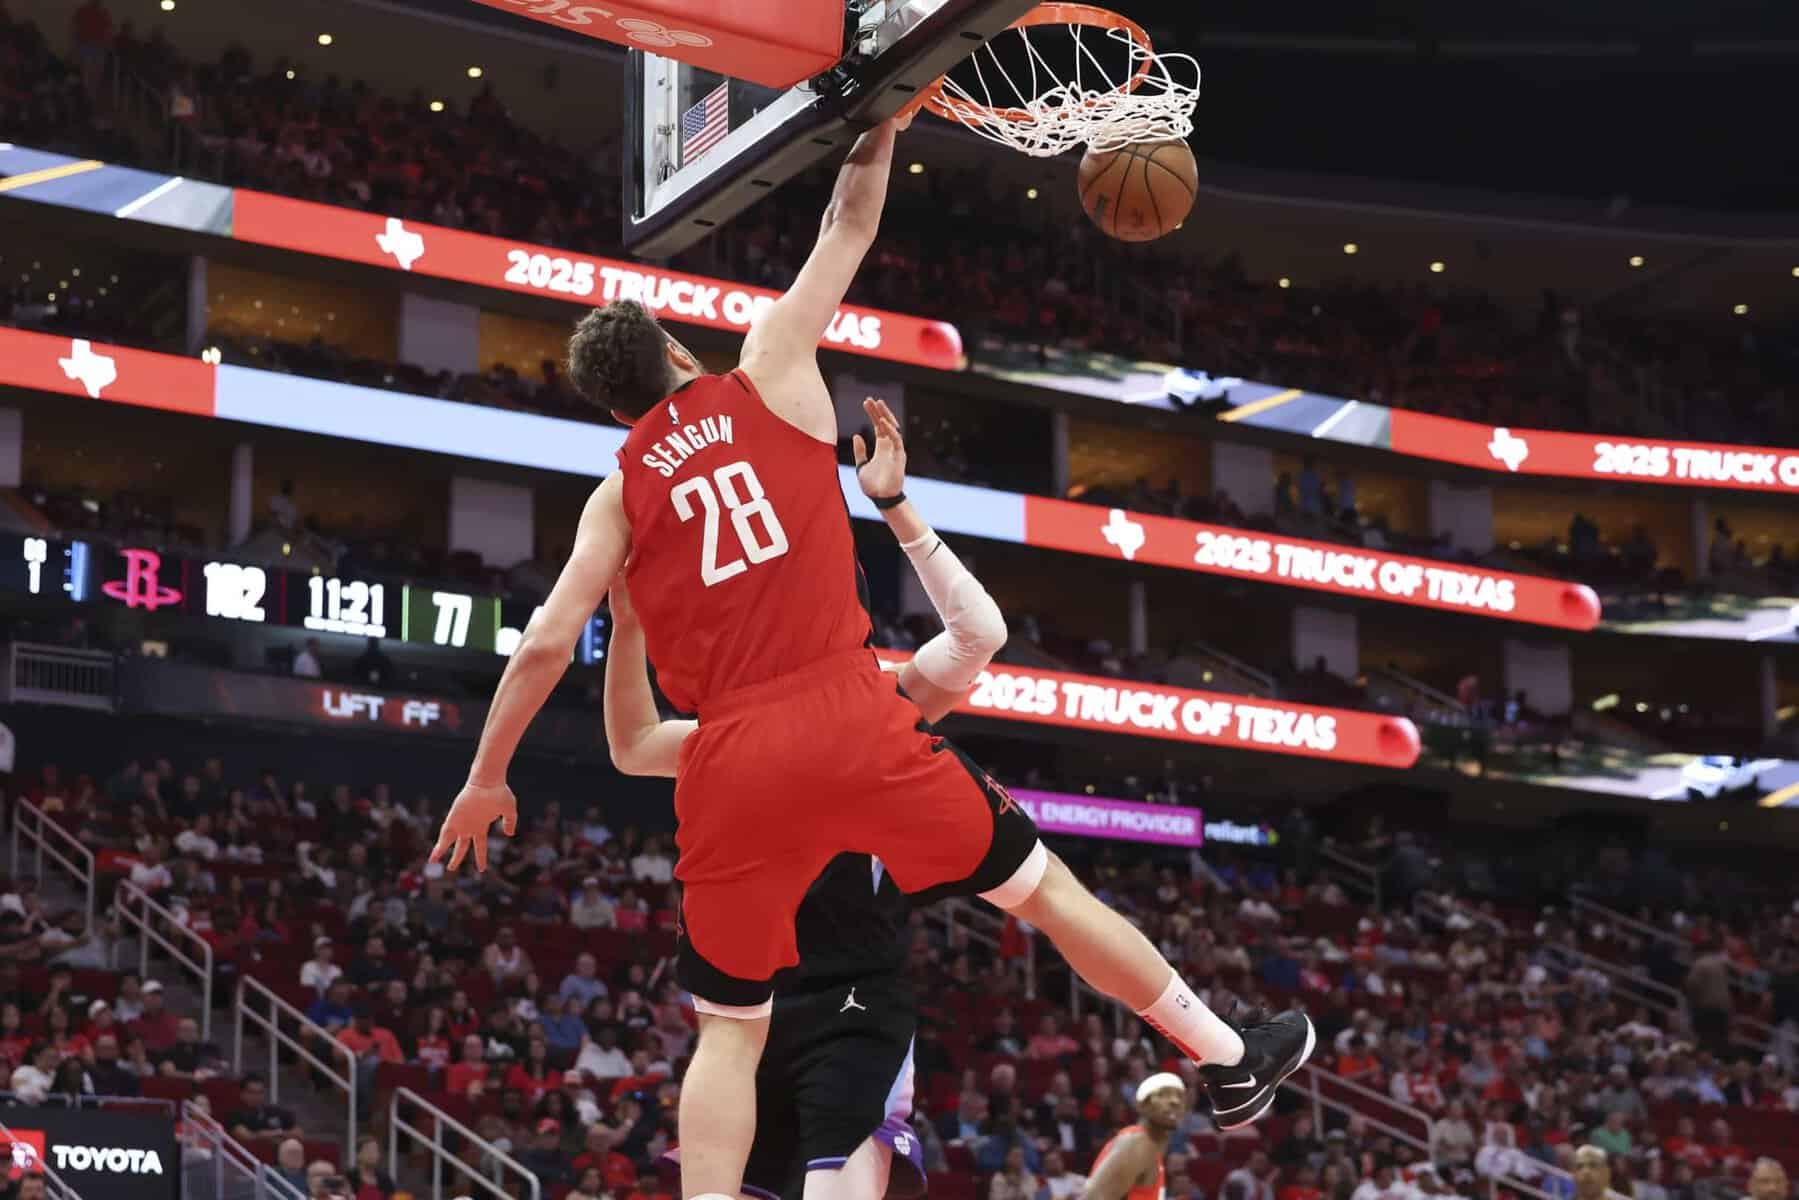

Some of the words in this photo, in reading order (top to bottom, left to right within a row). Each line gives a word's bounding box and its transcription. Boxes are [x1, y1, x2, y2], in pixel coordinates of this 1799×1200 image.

[504, 250, 595, 296] 2025
[600, 266, 720, 319] TRUCK
[642, 414, 734, 478] SENGUN
[1593, 442, 1670, 476] 2025
[1672, 448, 1776, 484] TRUCK
[1778, 456, 1799, 486] O
[670, 461, 789, 587] 28
[1194, 531, 1271, 573] 2025
[1275, 544, 1376, 590] TRUCK
[1379, 561, 1423, 596] OF
[1426, 568, 1515, 612] TEXAS
[432, 591, 472, 647] 77
[969, 671, 1058, 715] 2025
[1062, 681, 1179, 731] TRUCK
[1182, 698, 1233, 737] OF
[1235, 704, 1337, 751] TEXAS
[1041, 802, 1109, 828] ENERGY
[1111, 809, 1195, 836] PROVIDER
[52, 1145, 162, 1175] TOYOTA
